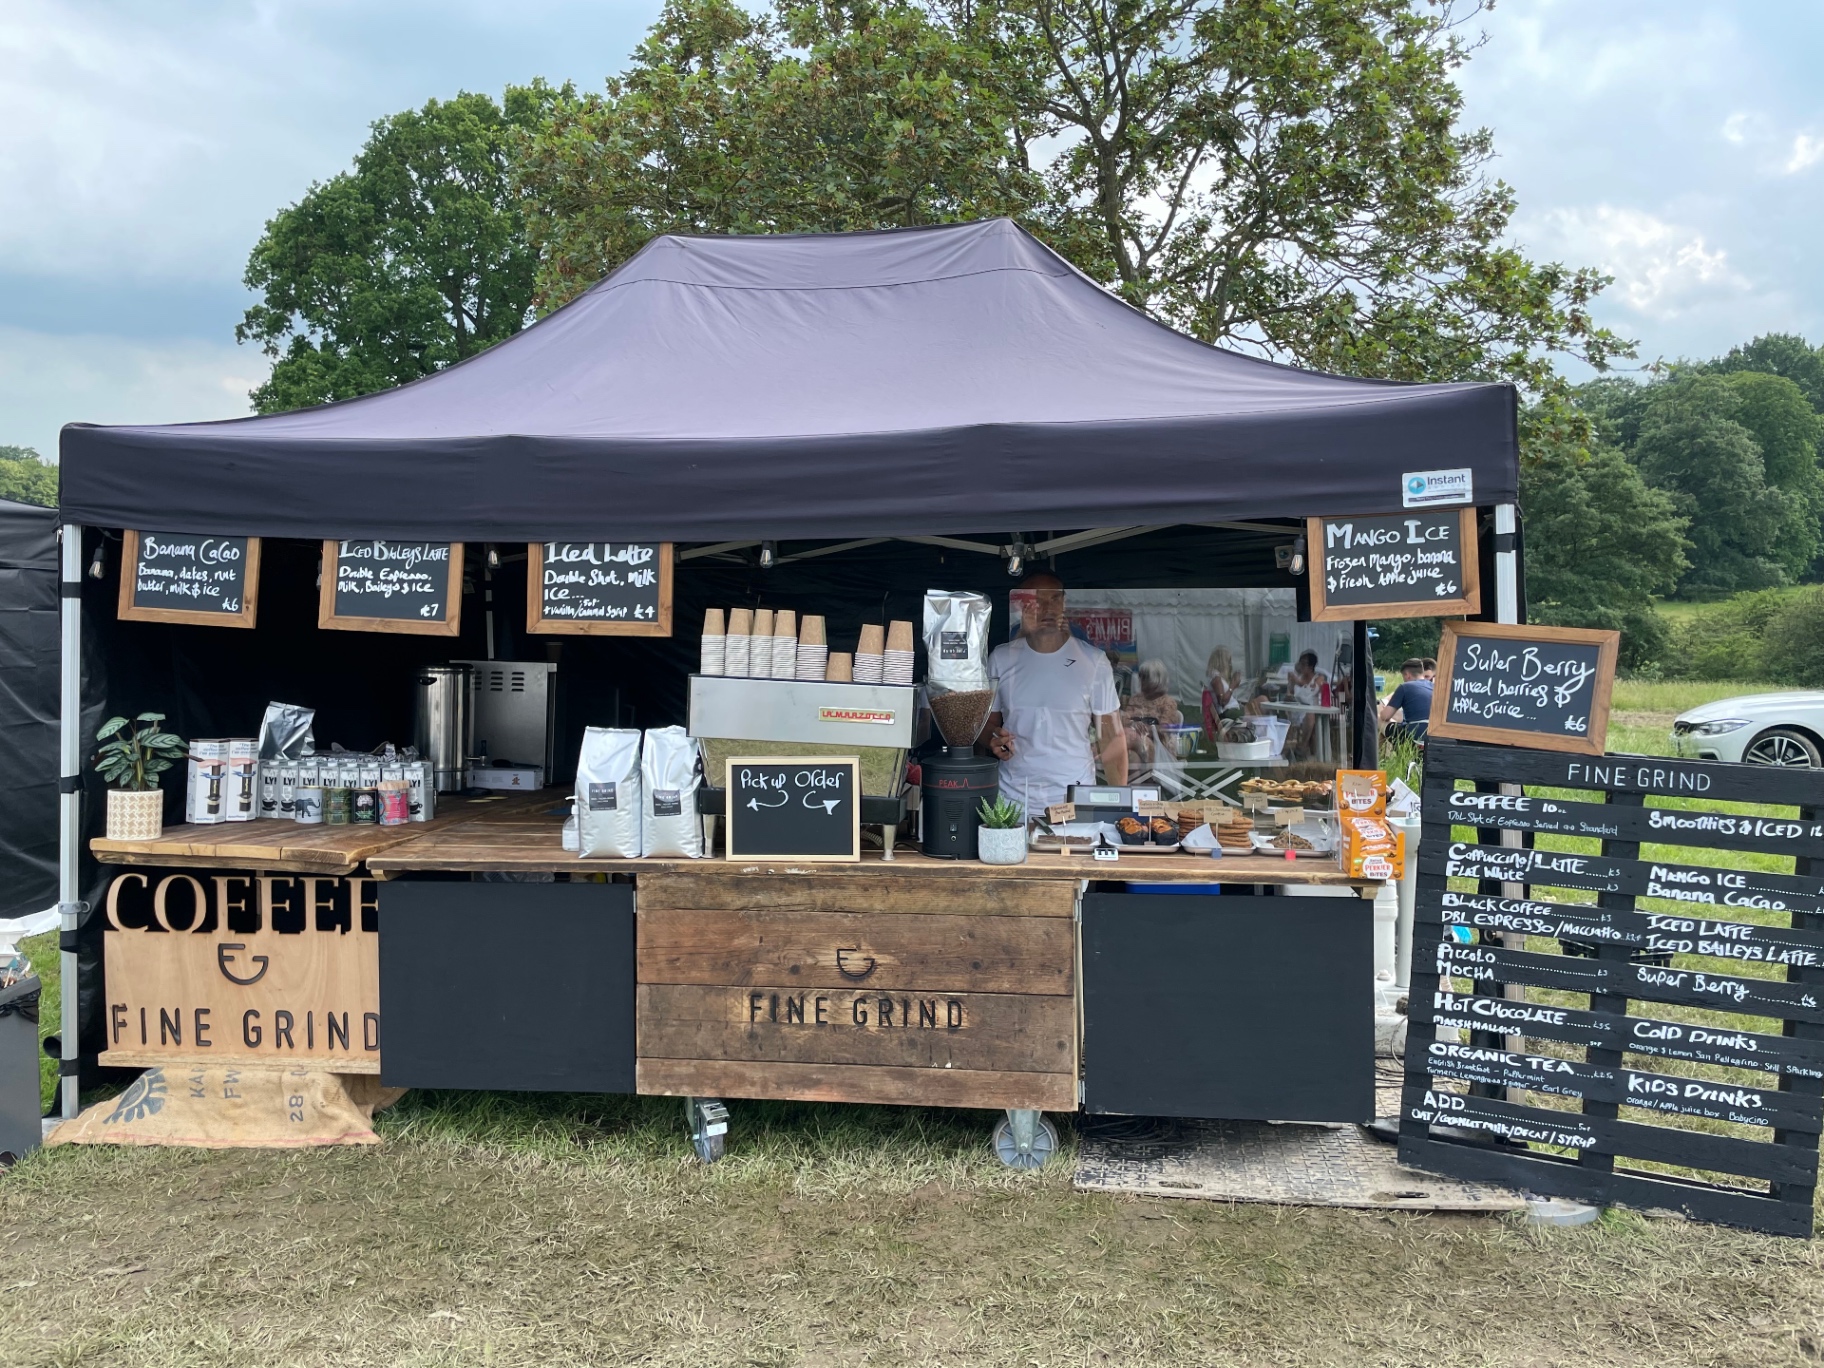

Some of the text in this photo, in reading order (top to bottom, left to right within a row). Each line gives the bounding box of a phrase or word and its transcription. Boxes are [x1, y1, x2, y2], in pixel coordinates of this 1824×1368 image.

[1427, 474, 1466, 486] Instant
[1326, 519, 1450, 549] MANGO ICE
[214, 569, 236, 581] nut
[338, 566, 374, 579] Double
[544, 569, 587, 585] Double
[1519, 646, 1596, 690] Berry
[740, 768, 769, 790] Pick
[794, 769, 845, 789] Order
[938, 779, 959, 788] PEAK
[1567, 763, 1711, 792] FINE GRIND
[1449, 792, 1532, 812] COFFEE
[1753, 820, 1803, 839] ICED
[1716, 873, 1747, 889] ICE
[106, 873, 378, 934] COFFEE
[1442, 893, 1498, 912] BLACK
[1647, 881, 1716, 905] Banana
[1647, 914, 1755, 941] ICED LATTE
[1646, 934, 1694, 954] ICED
[1436, 959, 1494, 981] MOCHA
[1692, 974, 1750, 1003] Berry
[751, 994, 962, 1029] FINE GRIND
[1473, 998, 1568, 1025] CHOCOLATE
[111, 1003, 380, 1052] FINE GRIND
[1428, 1043, 1575, 1076] ORGANIC TEA
[1627, 1073, 1679, 1096] KIDS
[289, 1095, 304, 1123] 28
[1423, 1090, 1466, 1111] ADD
